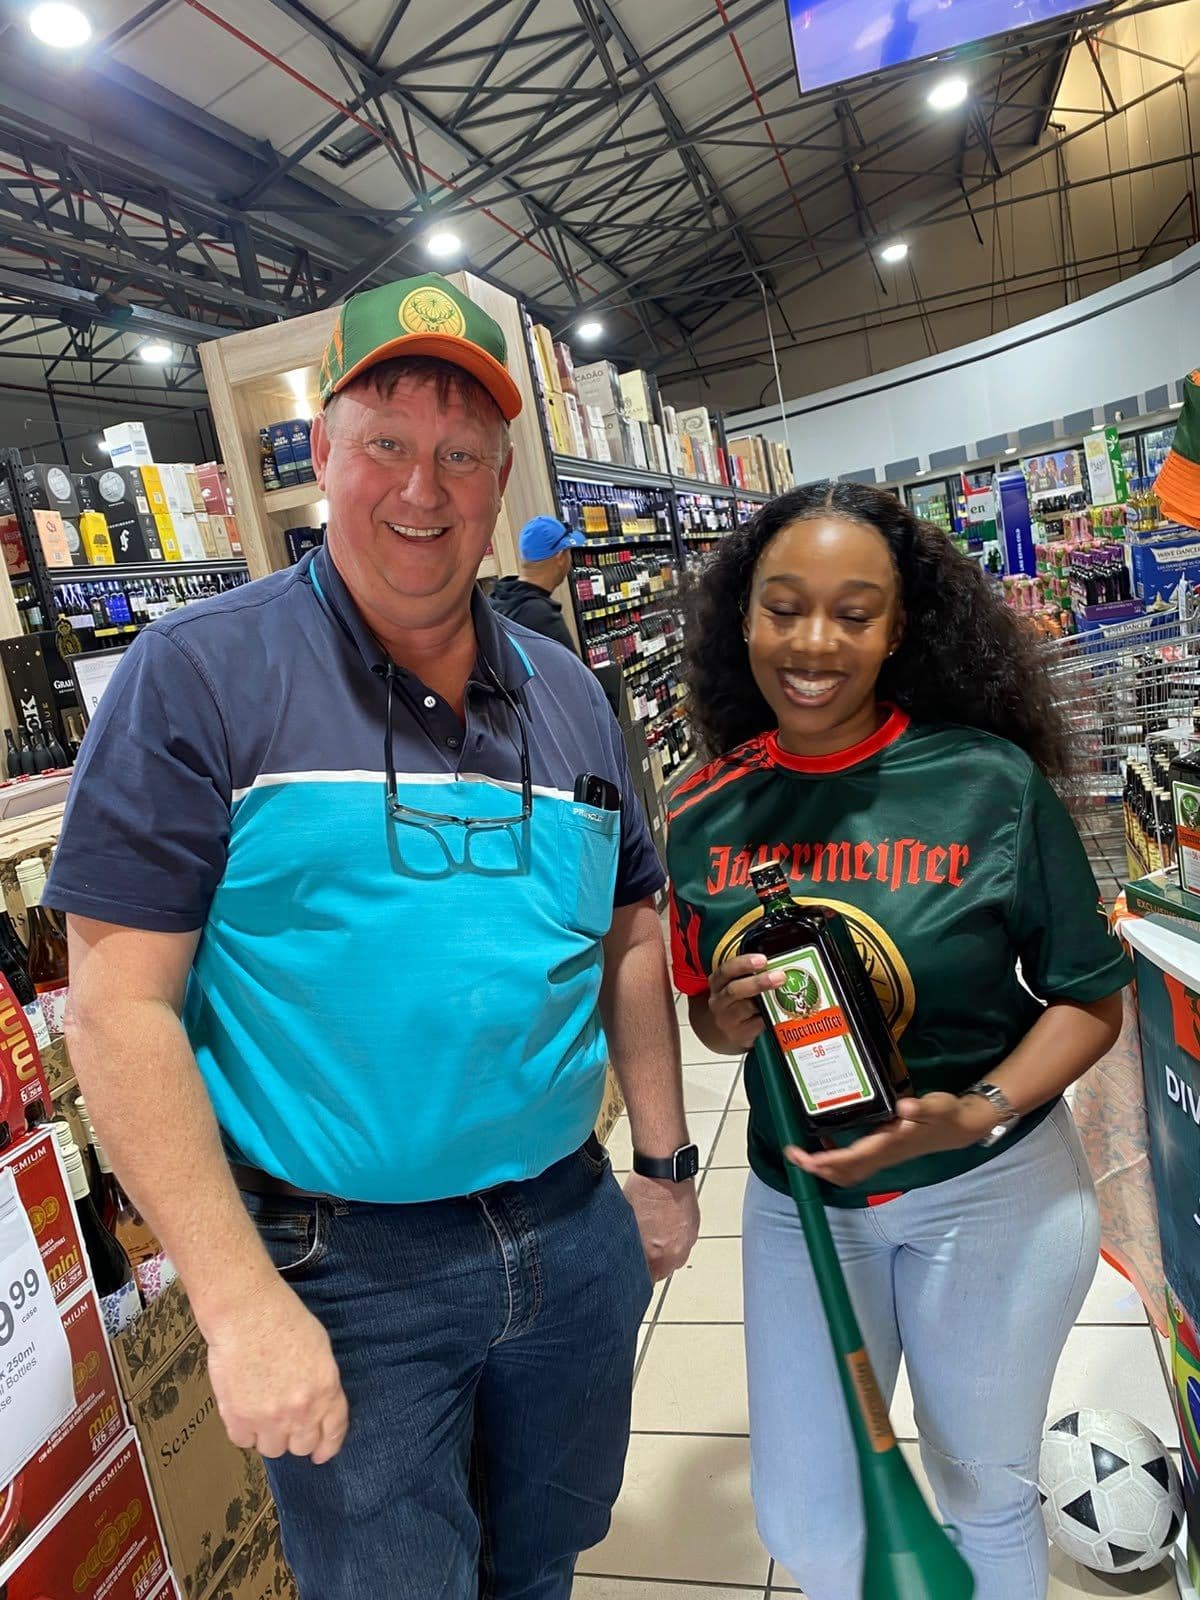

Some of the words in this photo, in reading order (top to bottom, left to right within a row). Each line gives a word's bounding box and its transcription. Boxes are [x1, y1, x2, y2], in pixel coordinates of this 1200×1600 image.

[813, 1045, 826, 1058] 56
[21, 1305, 38, 1324] case
[6, 1341, 36, 1373] 250ml
[7, 1357, 38, 1390] Bottles
[88, 1396, 118, 1439] mini
[87, 1450, 132, 1503] PREMIUM
